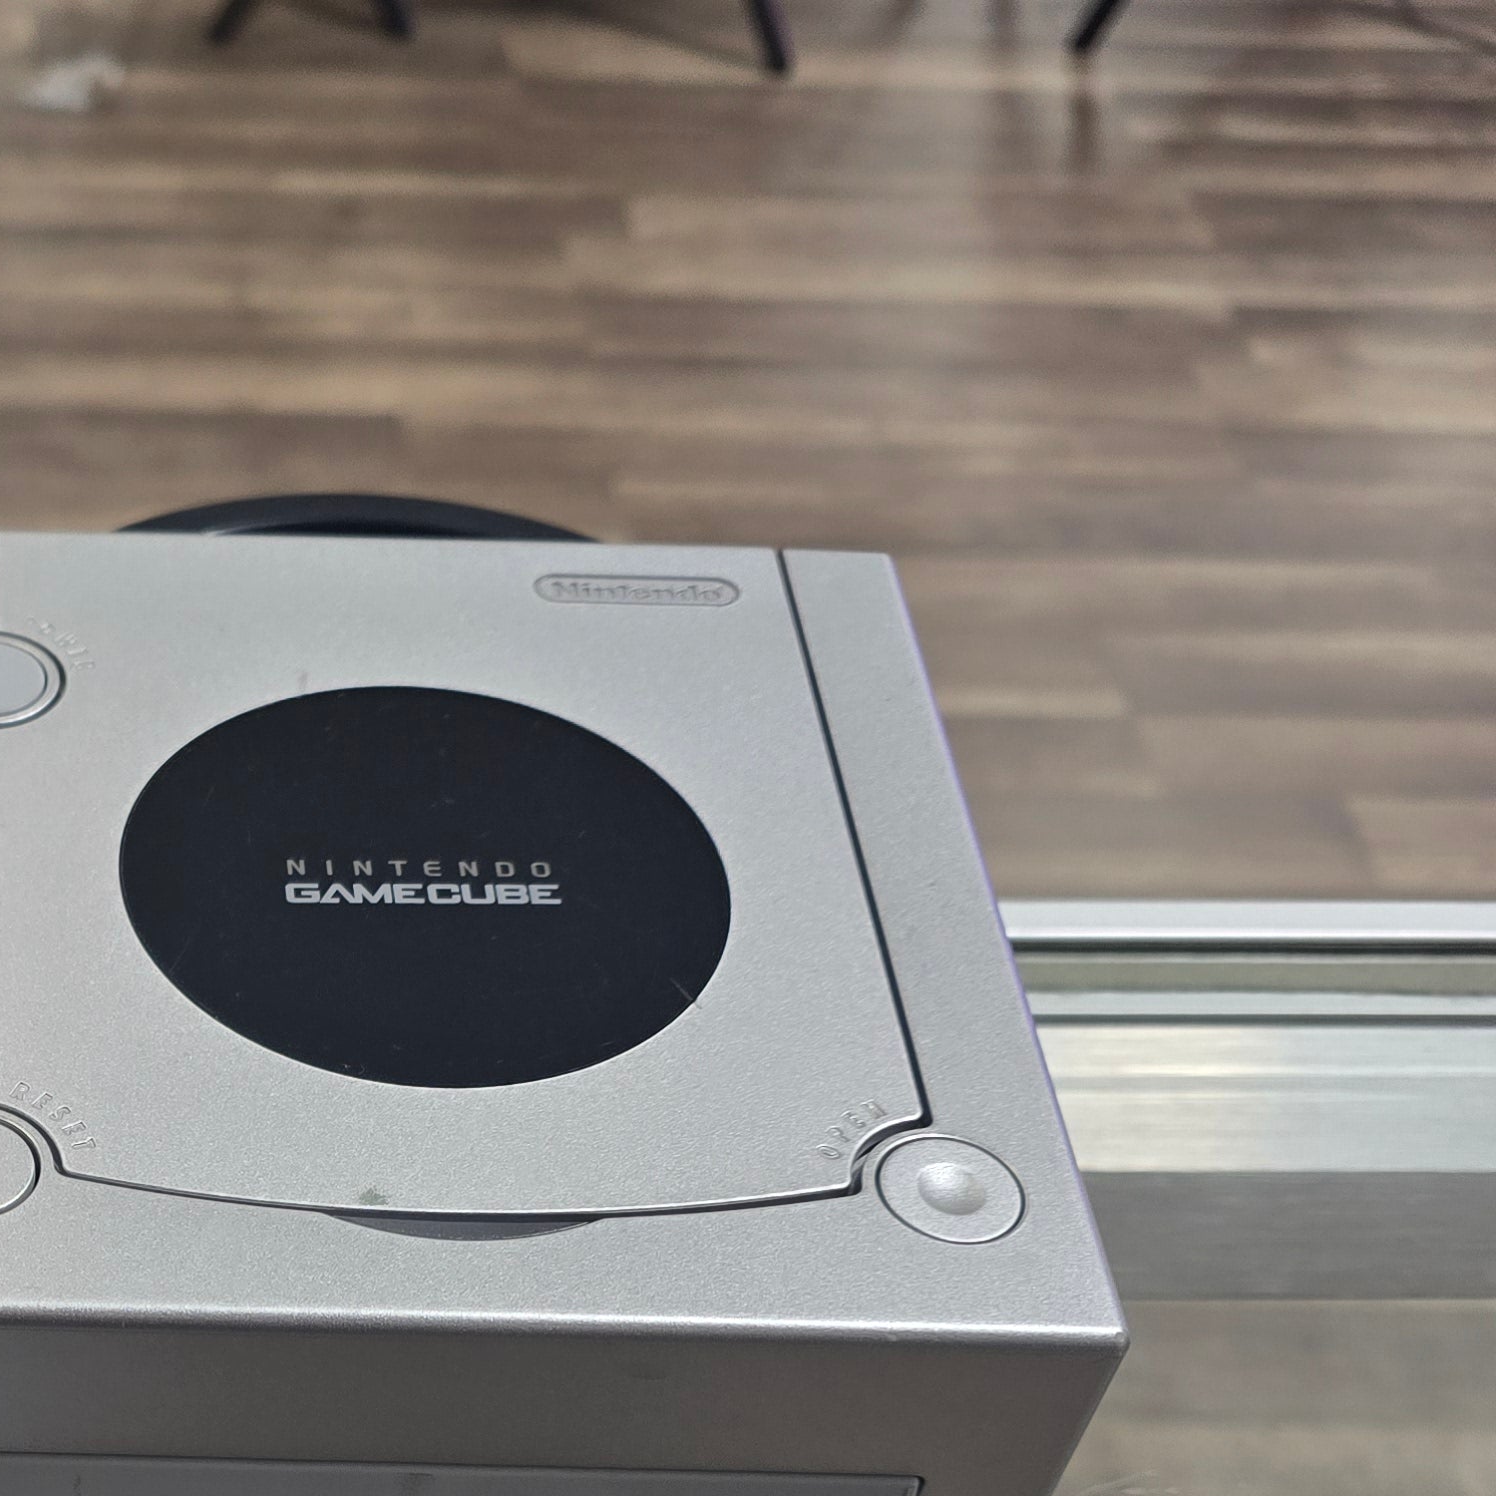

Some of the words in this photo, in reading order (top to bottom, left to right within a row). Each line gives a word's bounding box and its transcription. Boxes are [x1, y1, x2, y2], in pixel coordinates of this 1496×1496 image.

[550, 579, 723, 602] Nintendo
[286, 858, 551, 878] NINTENDO
[284, 883, 562, 905] GAMECUBE
[8, 1081, 96, 1151] RESET
[815, 1098, 888, 1160] OPEN
